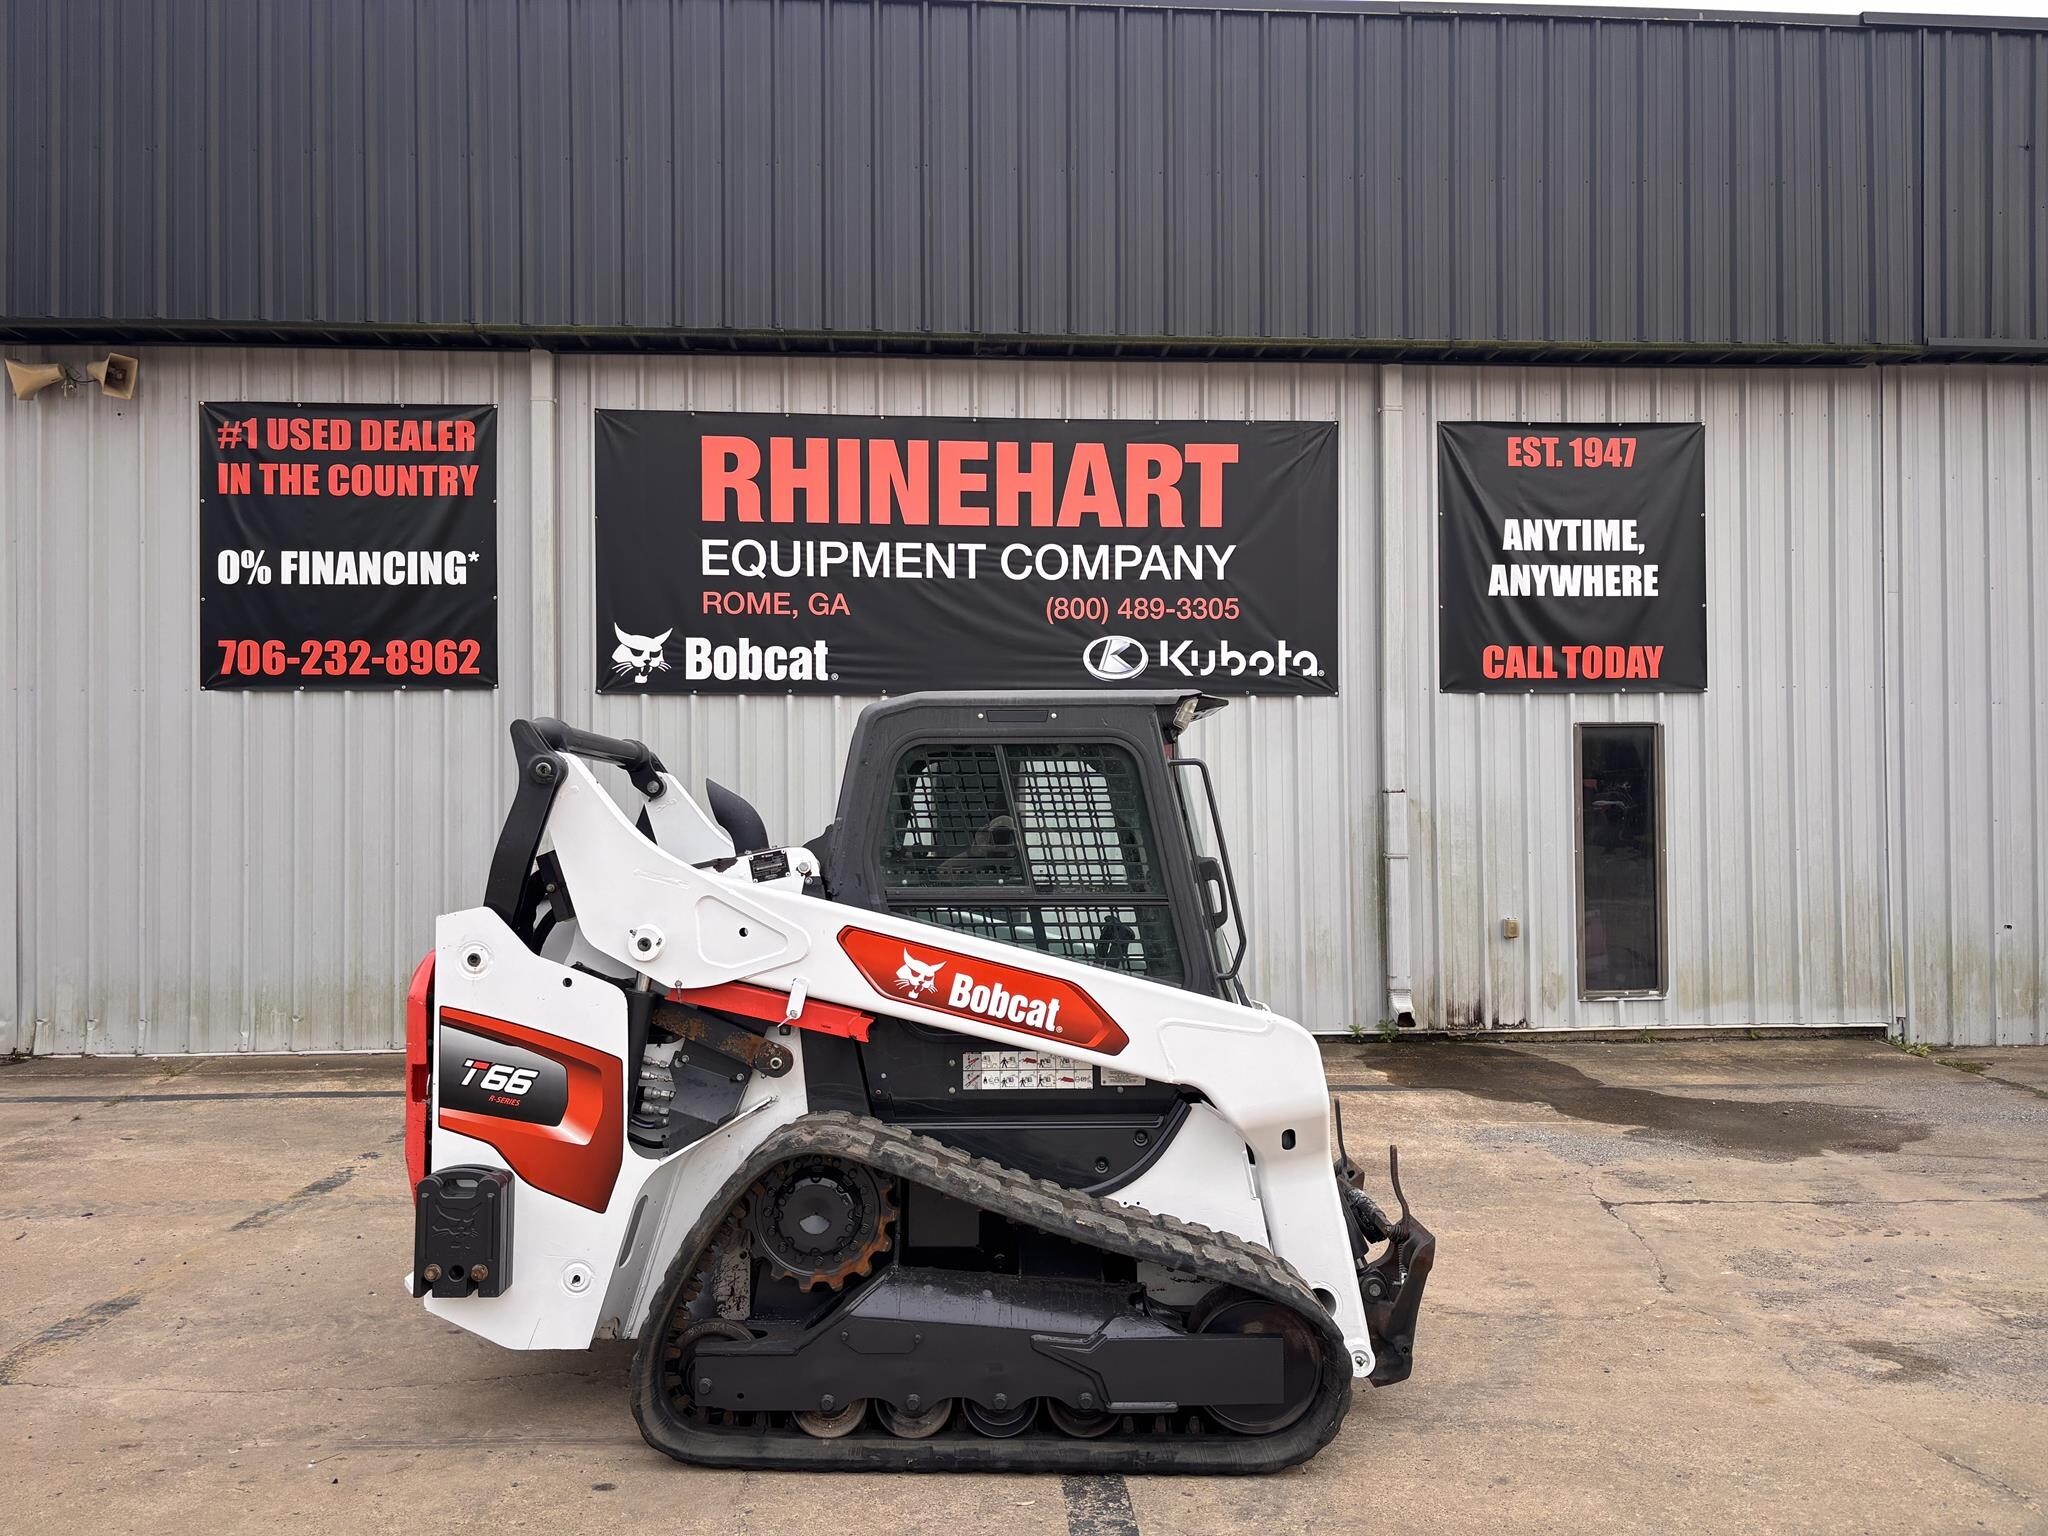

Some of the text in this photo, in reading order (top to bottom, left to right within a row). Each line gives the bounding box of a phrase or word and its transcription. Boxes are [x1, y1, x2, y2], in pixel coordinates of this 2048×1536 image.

[217, 417, 476, 452] #1 USED DEALER
[1507, 436, 1637, 468] EST. 1947
[217, 463, 480, 497] IN THE COUNTRY
[701, 435, 1239, 528] RHINEHART
[1502, 519, 1645, 555] ANYTIME,
[217, 549, 272, 585] 0%
[701, 539, 1236, 581] EQUIPMENT COMPANY
[1488, 564, 1659, 597] ANYWHERE
[702, 591, 850, 620] ROME, GA
[1046, 597, 1240, 625] (800) 489-3305
[217, 639, 481, 676] 706-232-8962
[685, 637, 829, 681] Bobcat
[1160, 640, 1318, 677] Kubota
[1482, 645, 1664, 679] CALL TODAY
[948, 972, 1061, 1032] Bobcat
[460, 1058, 540, 1096] T66
[488, 1094, 521, 1107] R-SERIES
